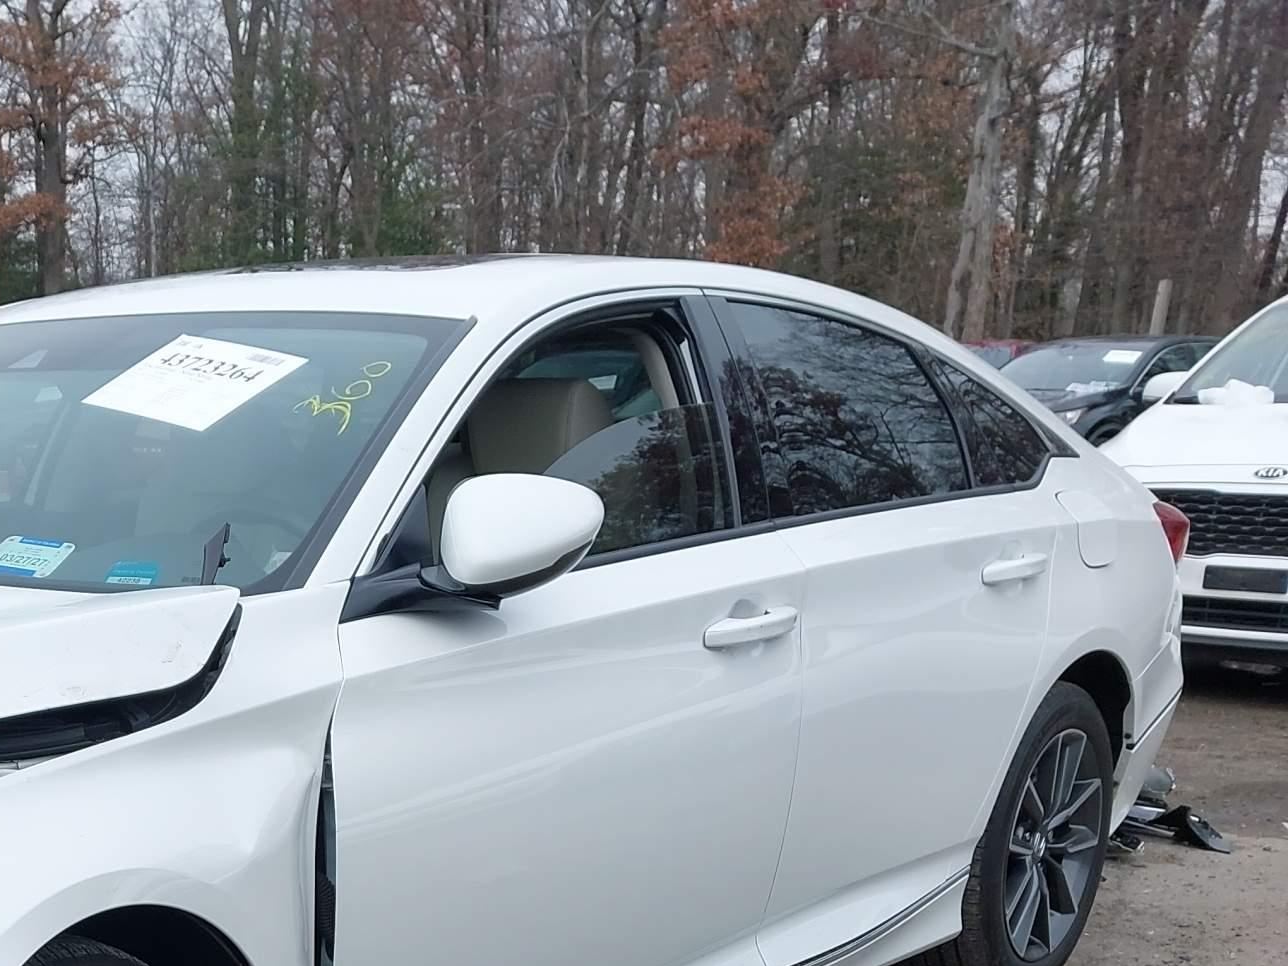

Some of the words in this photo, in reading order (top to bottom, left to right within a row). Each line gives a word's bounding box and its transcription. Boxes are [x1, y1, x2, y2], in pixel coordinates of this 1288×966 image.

[160, 352, 265, 383] 43723264
[1257, 467, 1285, 478] KIA
[0, 552, 47, 568] 03/27/27
